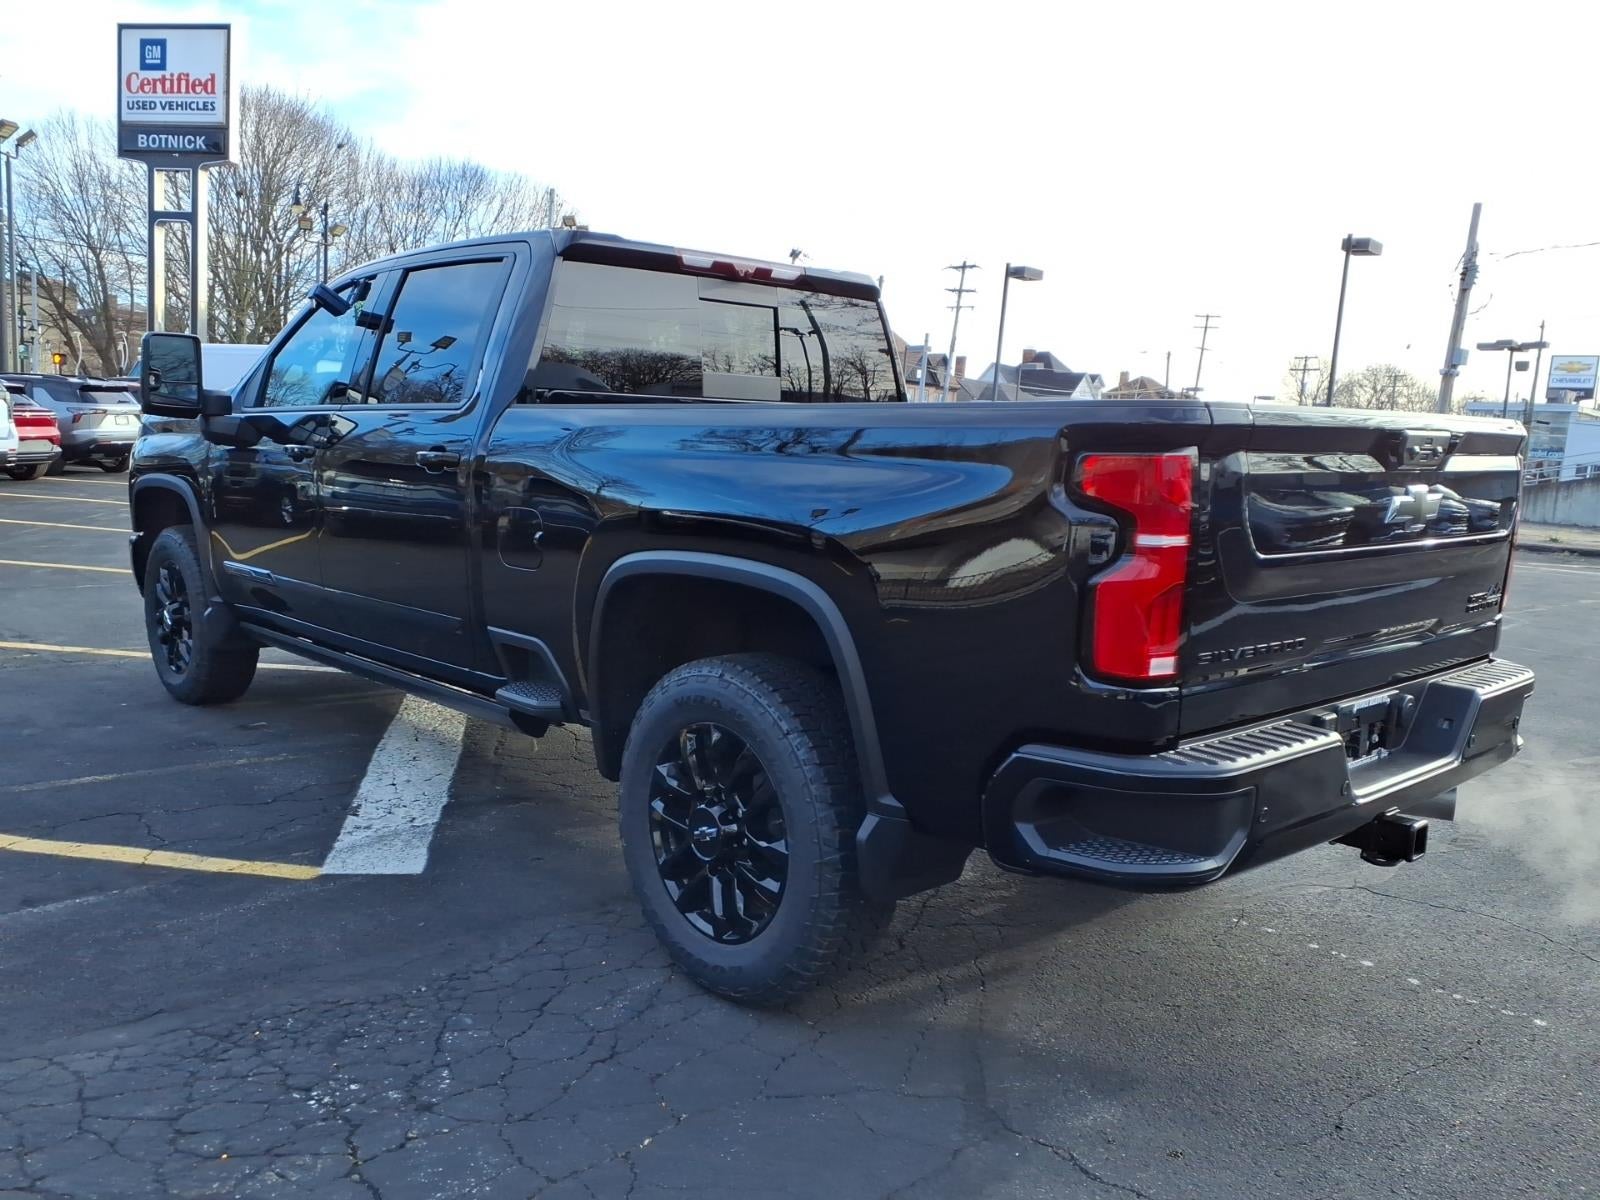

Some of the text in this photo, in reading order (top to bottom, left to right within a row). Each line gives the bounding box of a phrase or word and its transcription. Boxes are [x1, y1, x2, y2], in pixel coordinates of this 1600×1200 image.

[144, 45, 161, 60] GM
[125, 72, 216, 95] Certified
[126, 100, 216, 112] USED VEHICLES
[137, 134, 208, 150] BOTNICK
